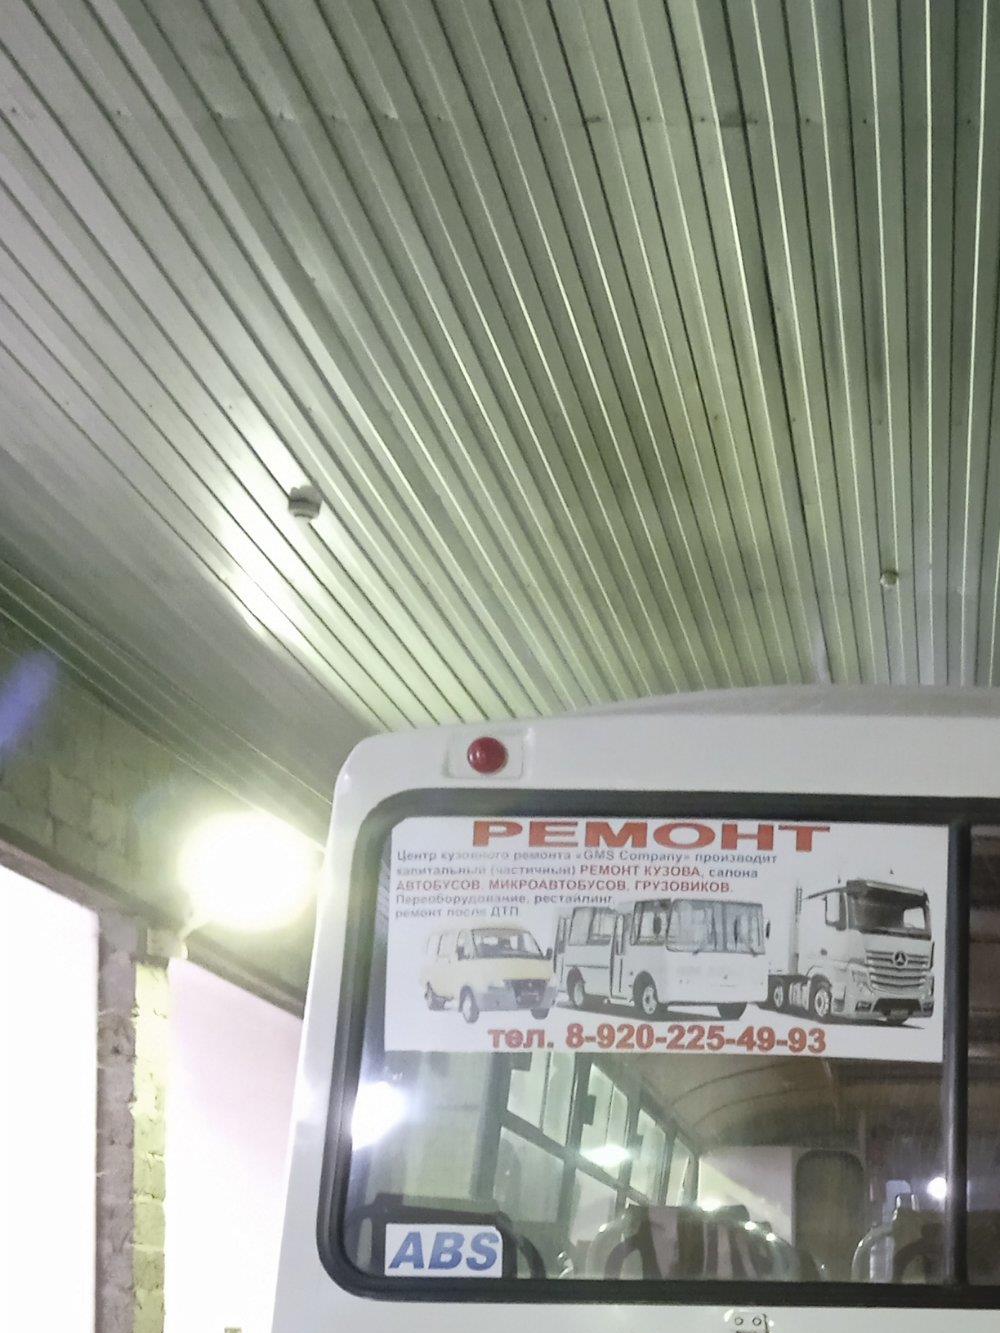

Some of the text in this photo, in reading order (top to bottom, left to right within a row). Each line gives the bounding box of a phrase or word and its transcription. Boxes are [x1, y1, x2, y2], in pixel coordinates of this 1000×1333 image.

[472, 820, 830, 852] РЕМОНТ
[397, 851, 437, 862] Центр
[441, 852, 509, 862] кузовного
[513, 852, 571, 863] ремонта
[695, 854, 777, 865] производит
[580, 865, 640, 877] РЕМОНТ
[644, 866, 704, 878] КУЗОВА,
[709, 869, 758, 879] салона
[395, 906, 519, 919] ремонт после ДТП
[487, 1022, 827, 1054] тел. 8-920-225-49-93
[388, 1231, 500, 1271] ABS
